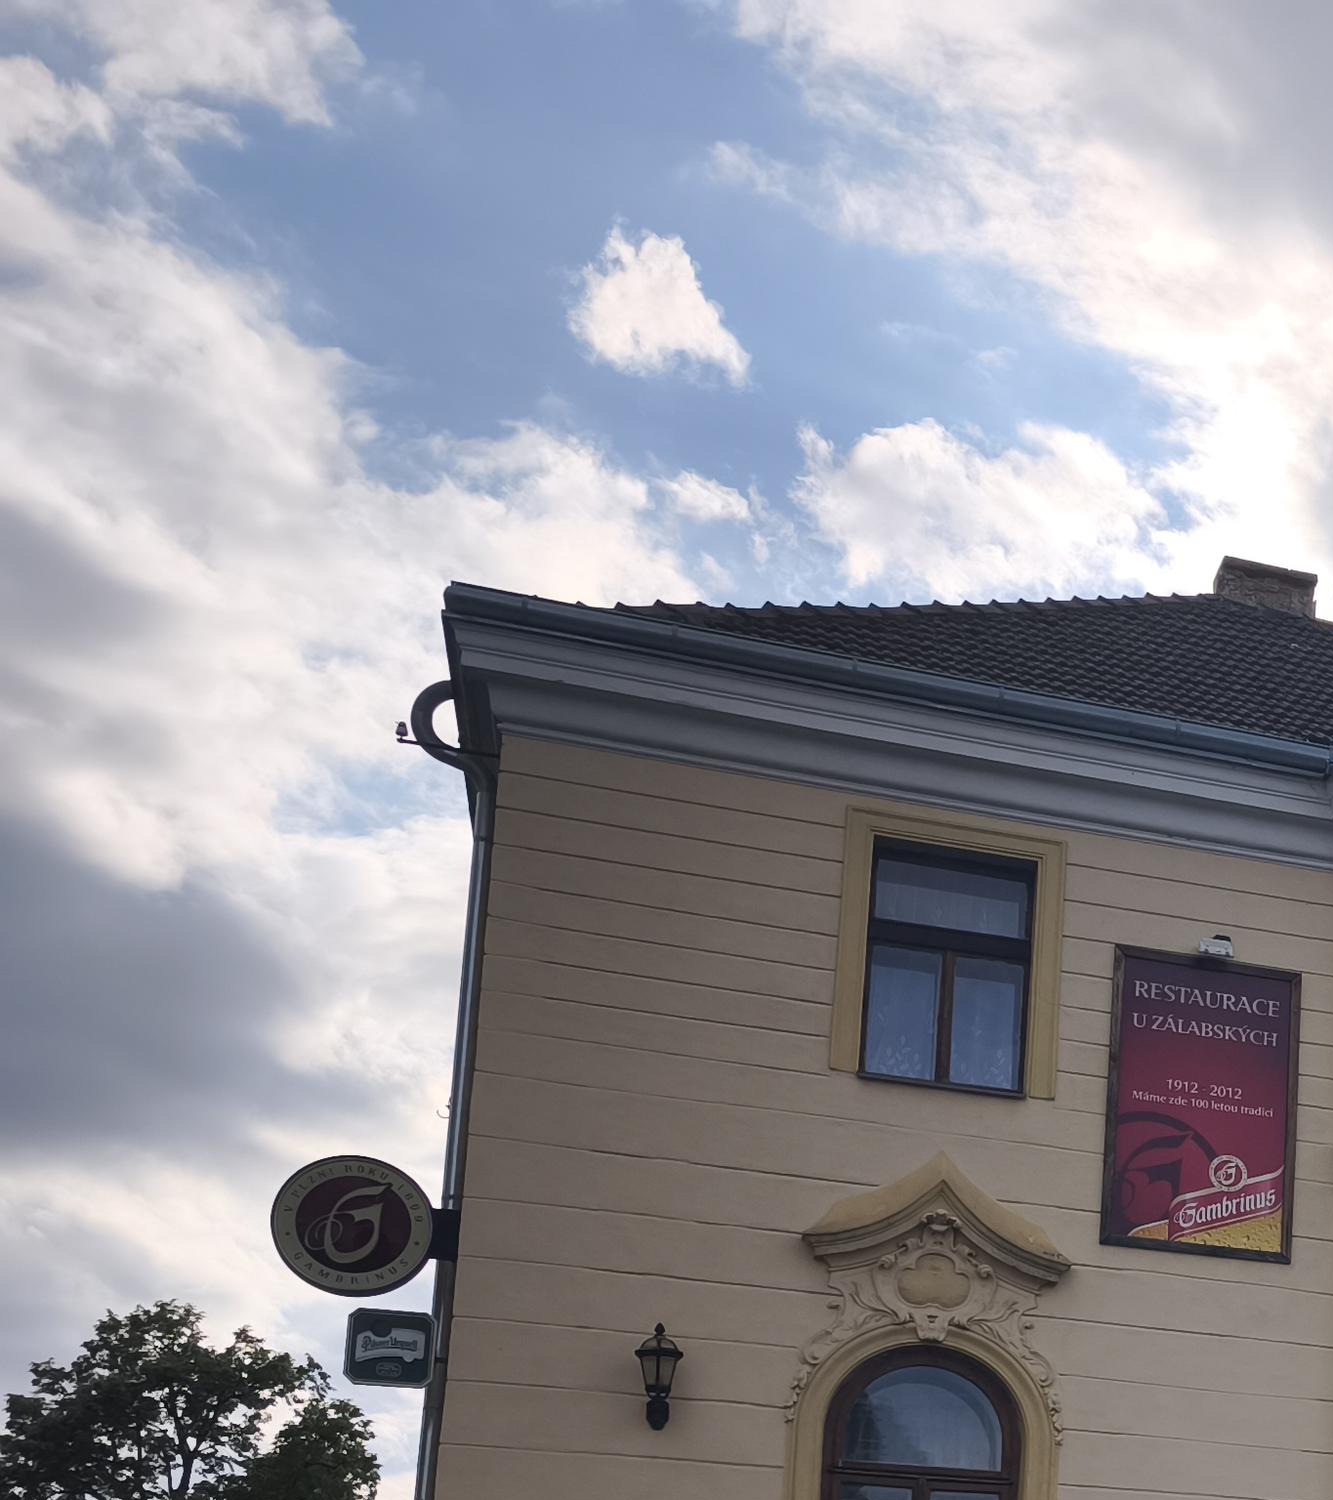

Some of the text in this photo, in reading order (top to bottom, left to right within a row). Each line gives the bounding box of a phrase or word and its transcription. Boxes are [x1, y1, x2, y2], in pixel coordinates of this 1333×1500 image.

[1134, 979, 1281, 1018] RESTAURACE
[1132, 1012, 1279, 1047] U ZÁLABSKÝCH
[1132, 1090, 1167, 1104] Máme
[1168, 1095, 1188, 1107] zde
[1191, 1098, 1209, 1109] 100
[1211, 1100, 1238, 1114] letou
[1166, 1078, 1199, 1094] 1912
[1210, 1084, 1242, 1100] 2012
[343, 1164, 390, 1181] ROKU
[1173, 1188, 1277, 1228] Gambrinus
[293, 1251, 410, 1286] GAMBRINUS
